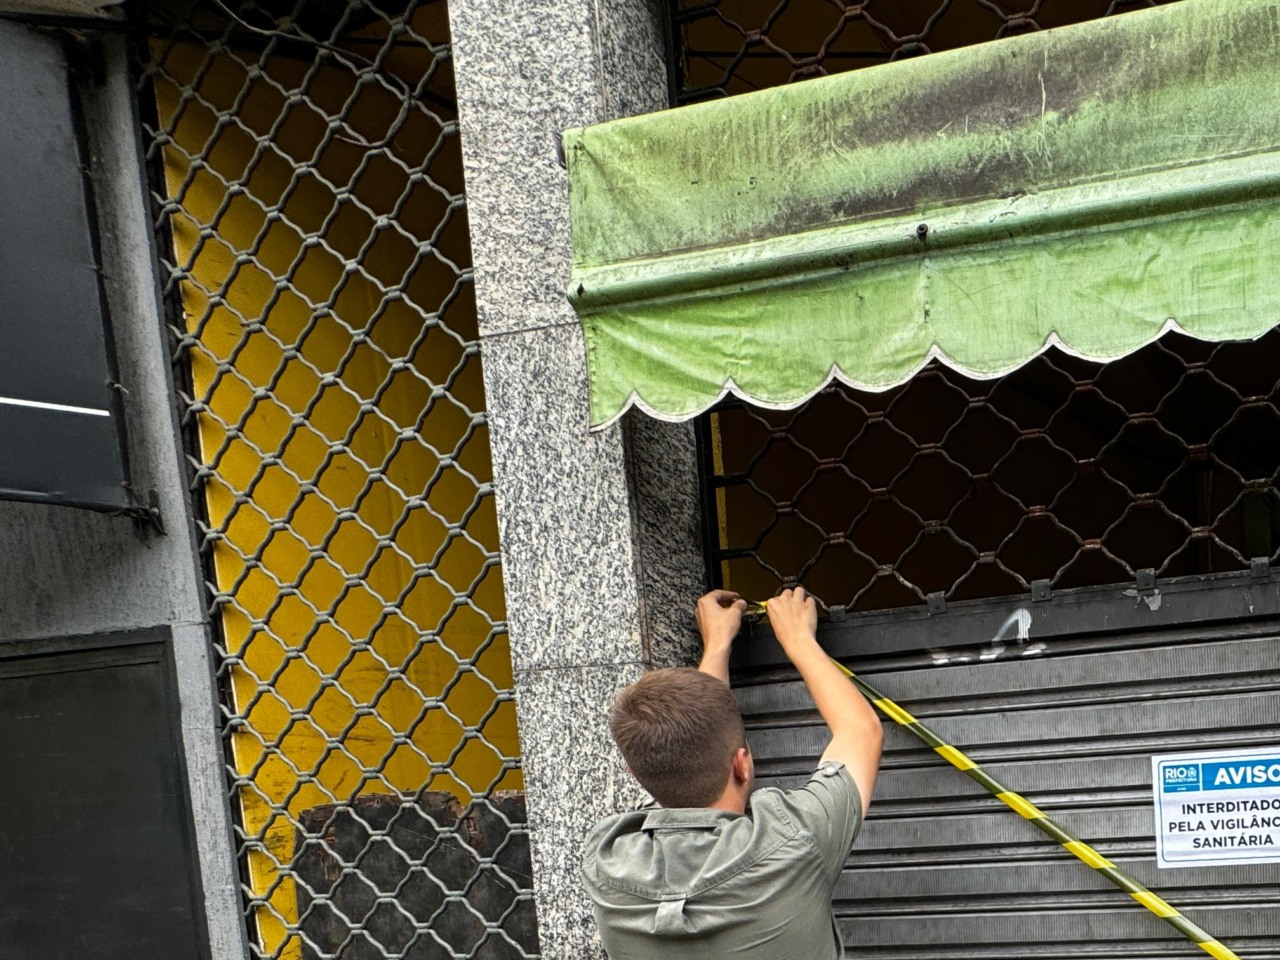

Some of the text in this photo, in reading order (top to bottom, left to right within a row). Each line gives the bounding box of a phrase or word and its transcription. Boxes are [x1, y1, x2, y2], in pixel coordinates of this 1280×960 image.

[1165, 767, 1187, 778] RIO
[1169, 820, 1206, 832] PELA
[1193, 833, 1274, 848] SANITÁRIA
